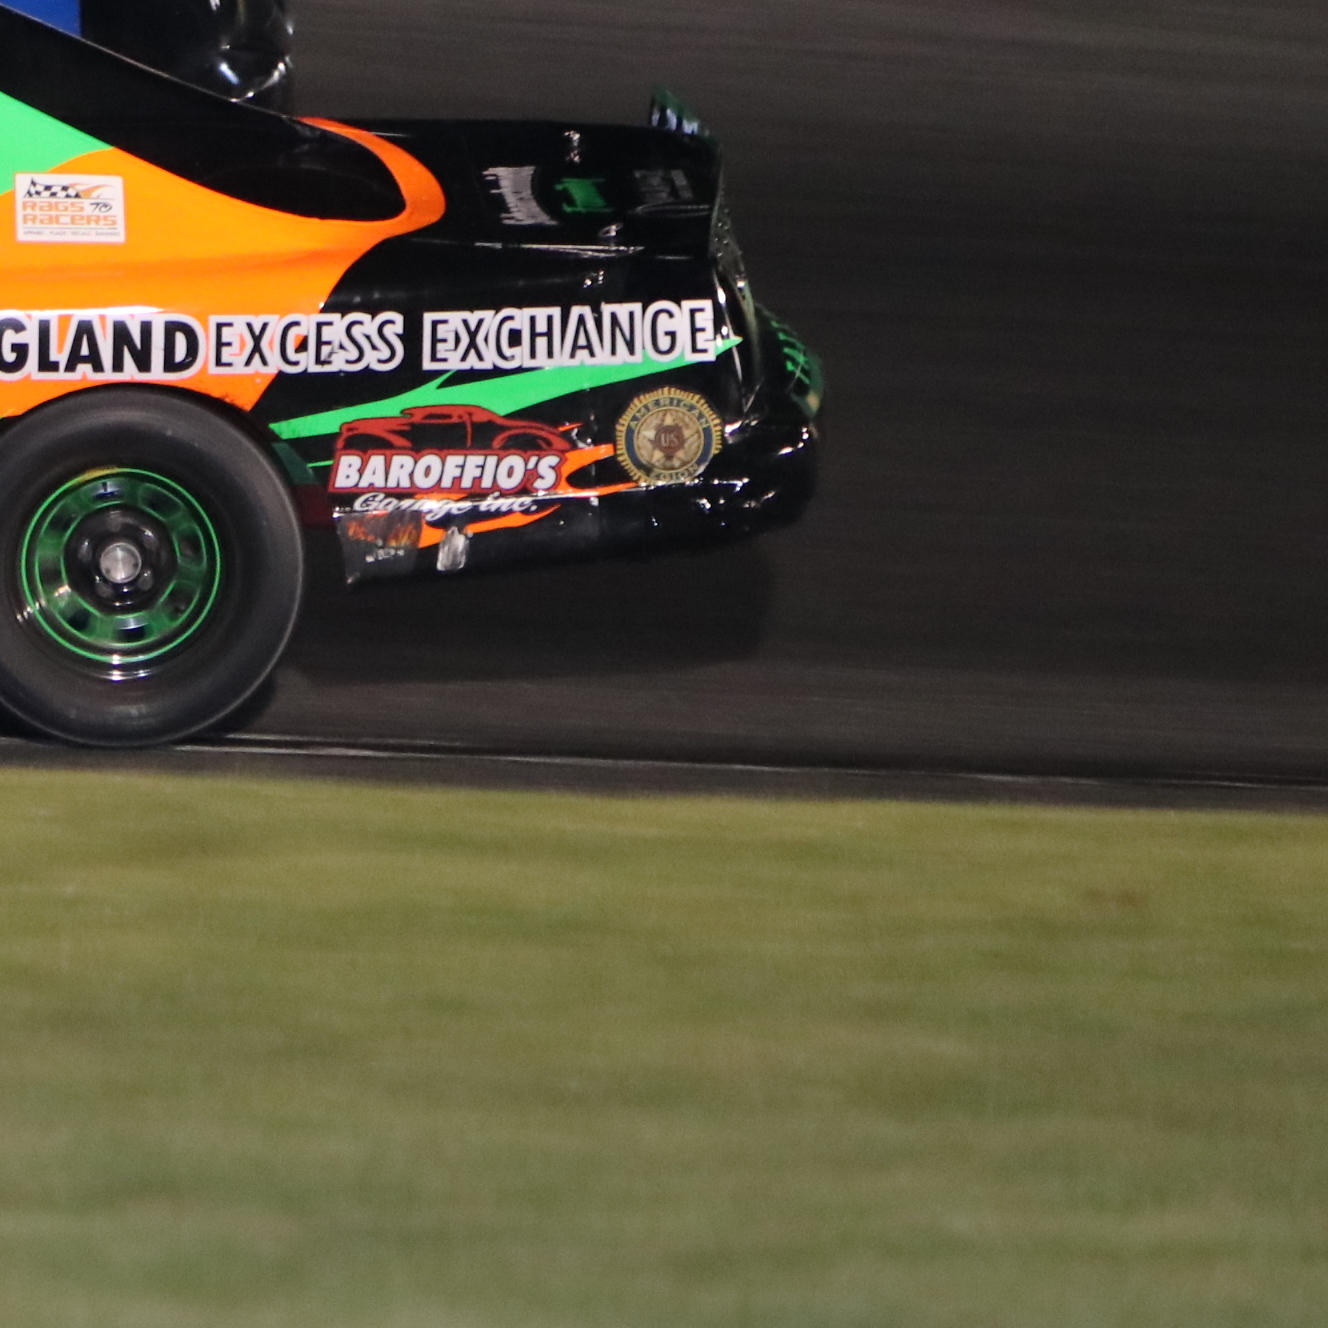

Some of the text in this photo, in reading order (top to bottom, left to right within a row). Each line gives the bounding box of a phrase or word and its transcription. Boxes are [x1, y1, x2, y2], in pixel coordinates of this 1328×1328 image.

[89, 201, 113, 213] TO
[214, 317, 402, 368] EXCESS
[428, 305, 714, 365] EXCHANGE
[333, 454, 561, 490] BAROFFIO'S
[353, 492, 473, 522] Garage
